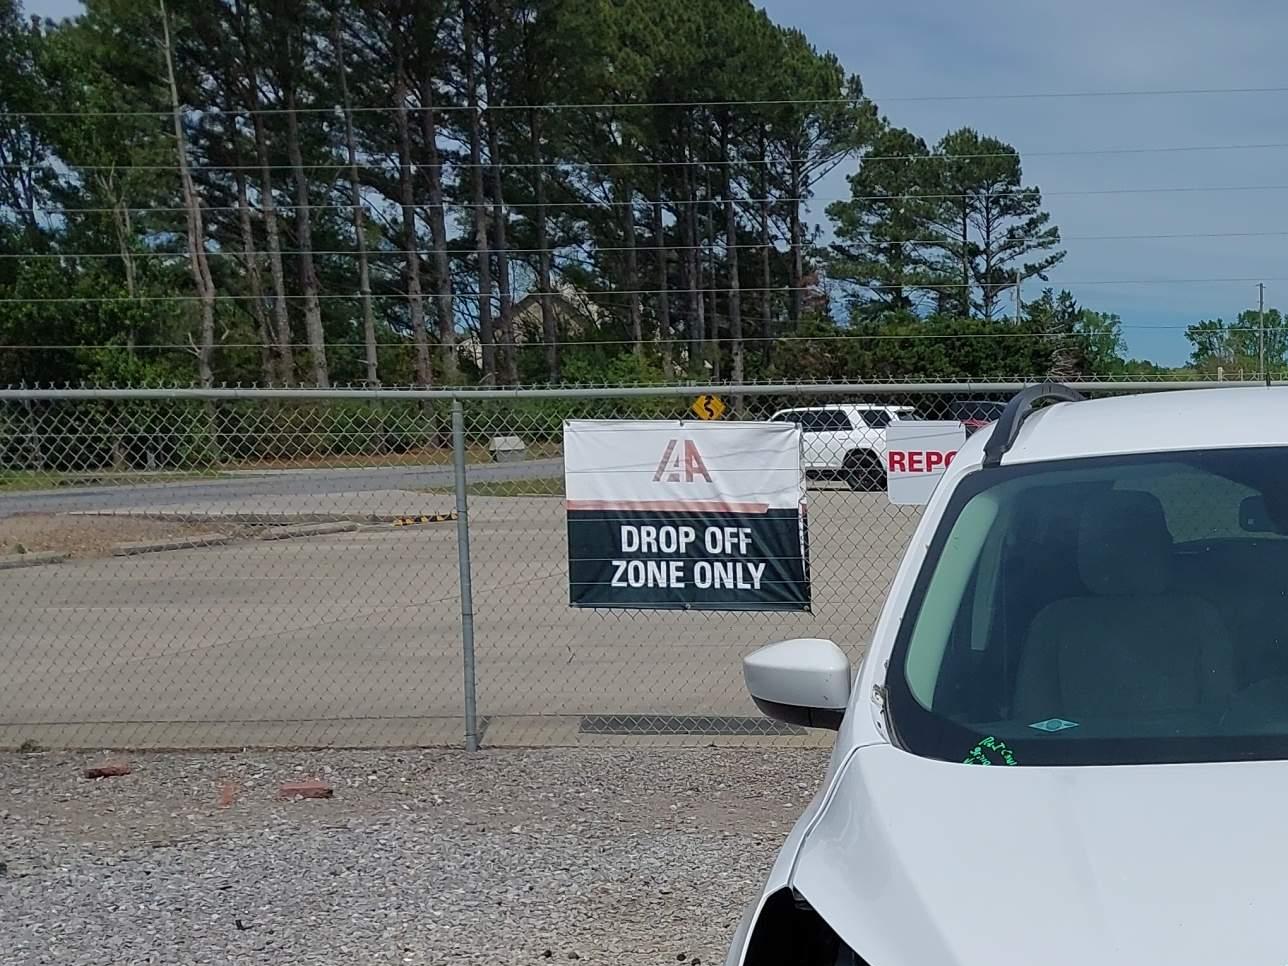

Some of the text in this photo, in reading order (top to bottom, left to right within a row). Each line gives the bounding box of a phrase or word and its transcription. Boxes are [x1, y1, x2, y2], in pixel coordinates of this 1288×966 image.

[621, 525, 752, 554] DROP OFF
[611, 560, 766, 590] ZONE ONLY
